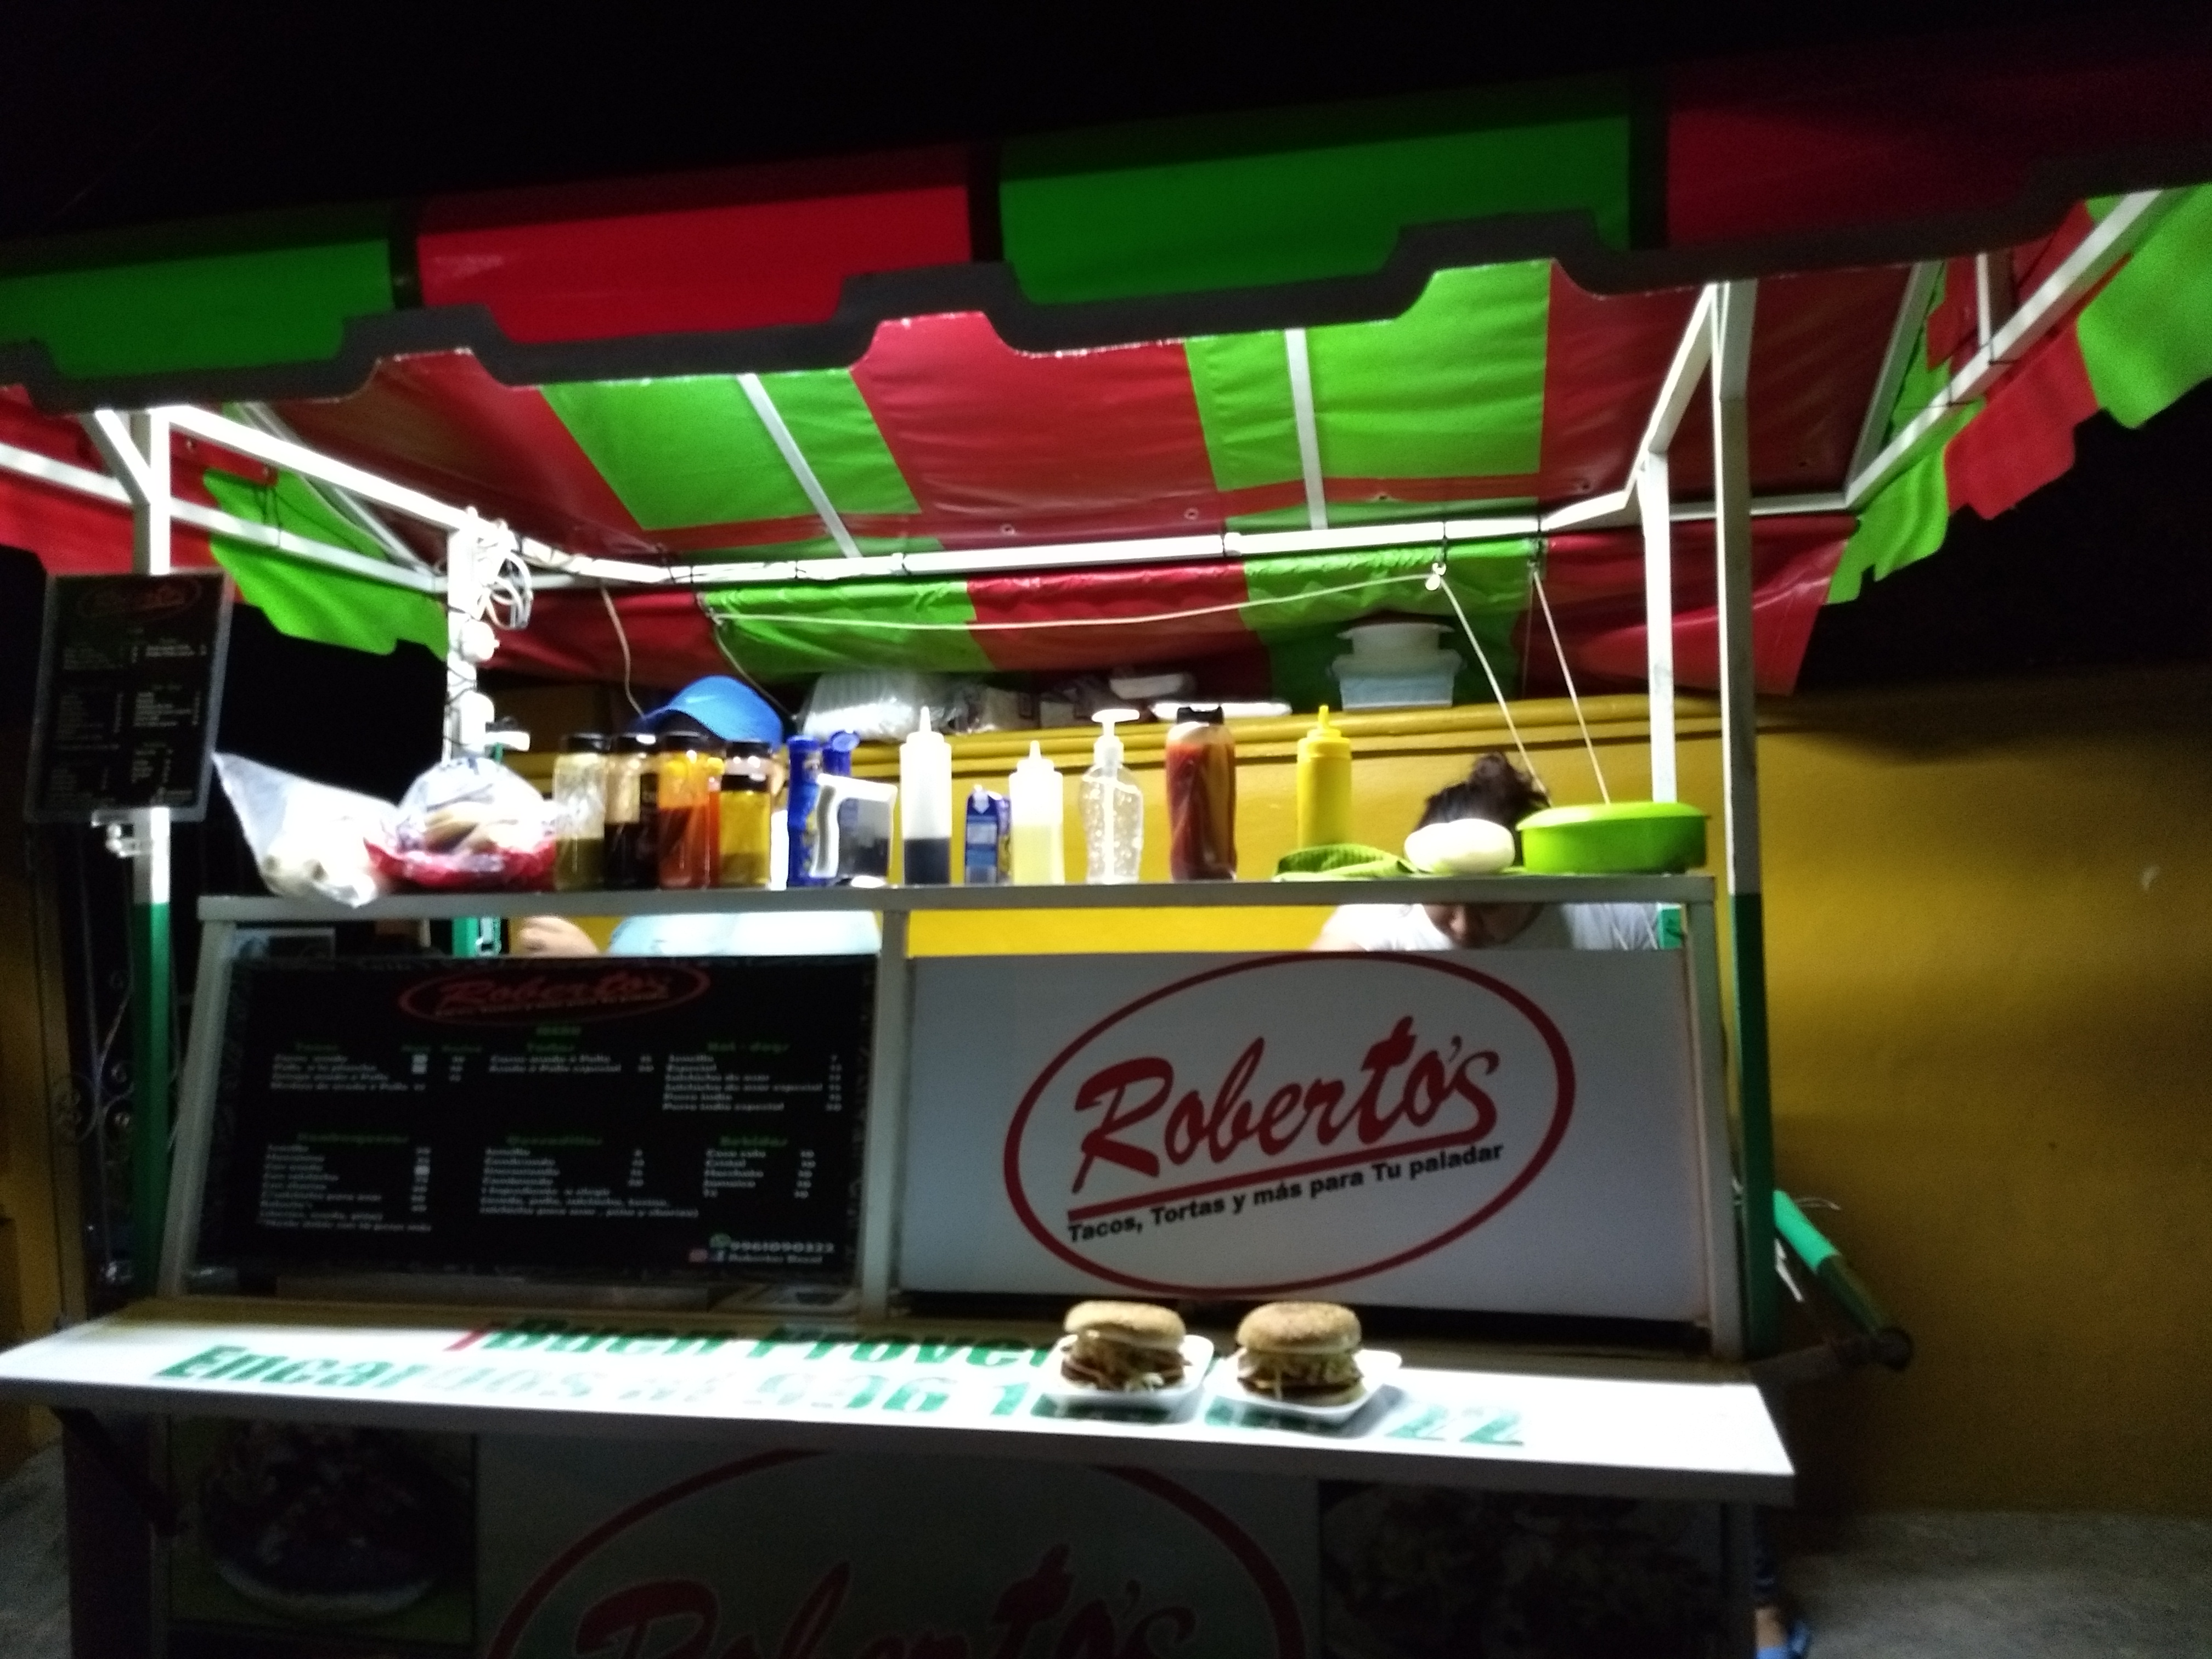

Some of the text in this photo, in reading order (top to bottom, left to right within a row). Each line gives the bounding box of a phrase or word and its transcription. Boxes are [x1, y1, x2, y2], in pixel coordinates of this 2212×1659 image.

[1071, 1015, 1500, 1194] Roberto's
[1068, 1144, 1503, 1242] Tacos, Tortas y más para Tu paladar
